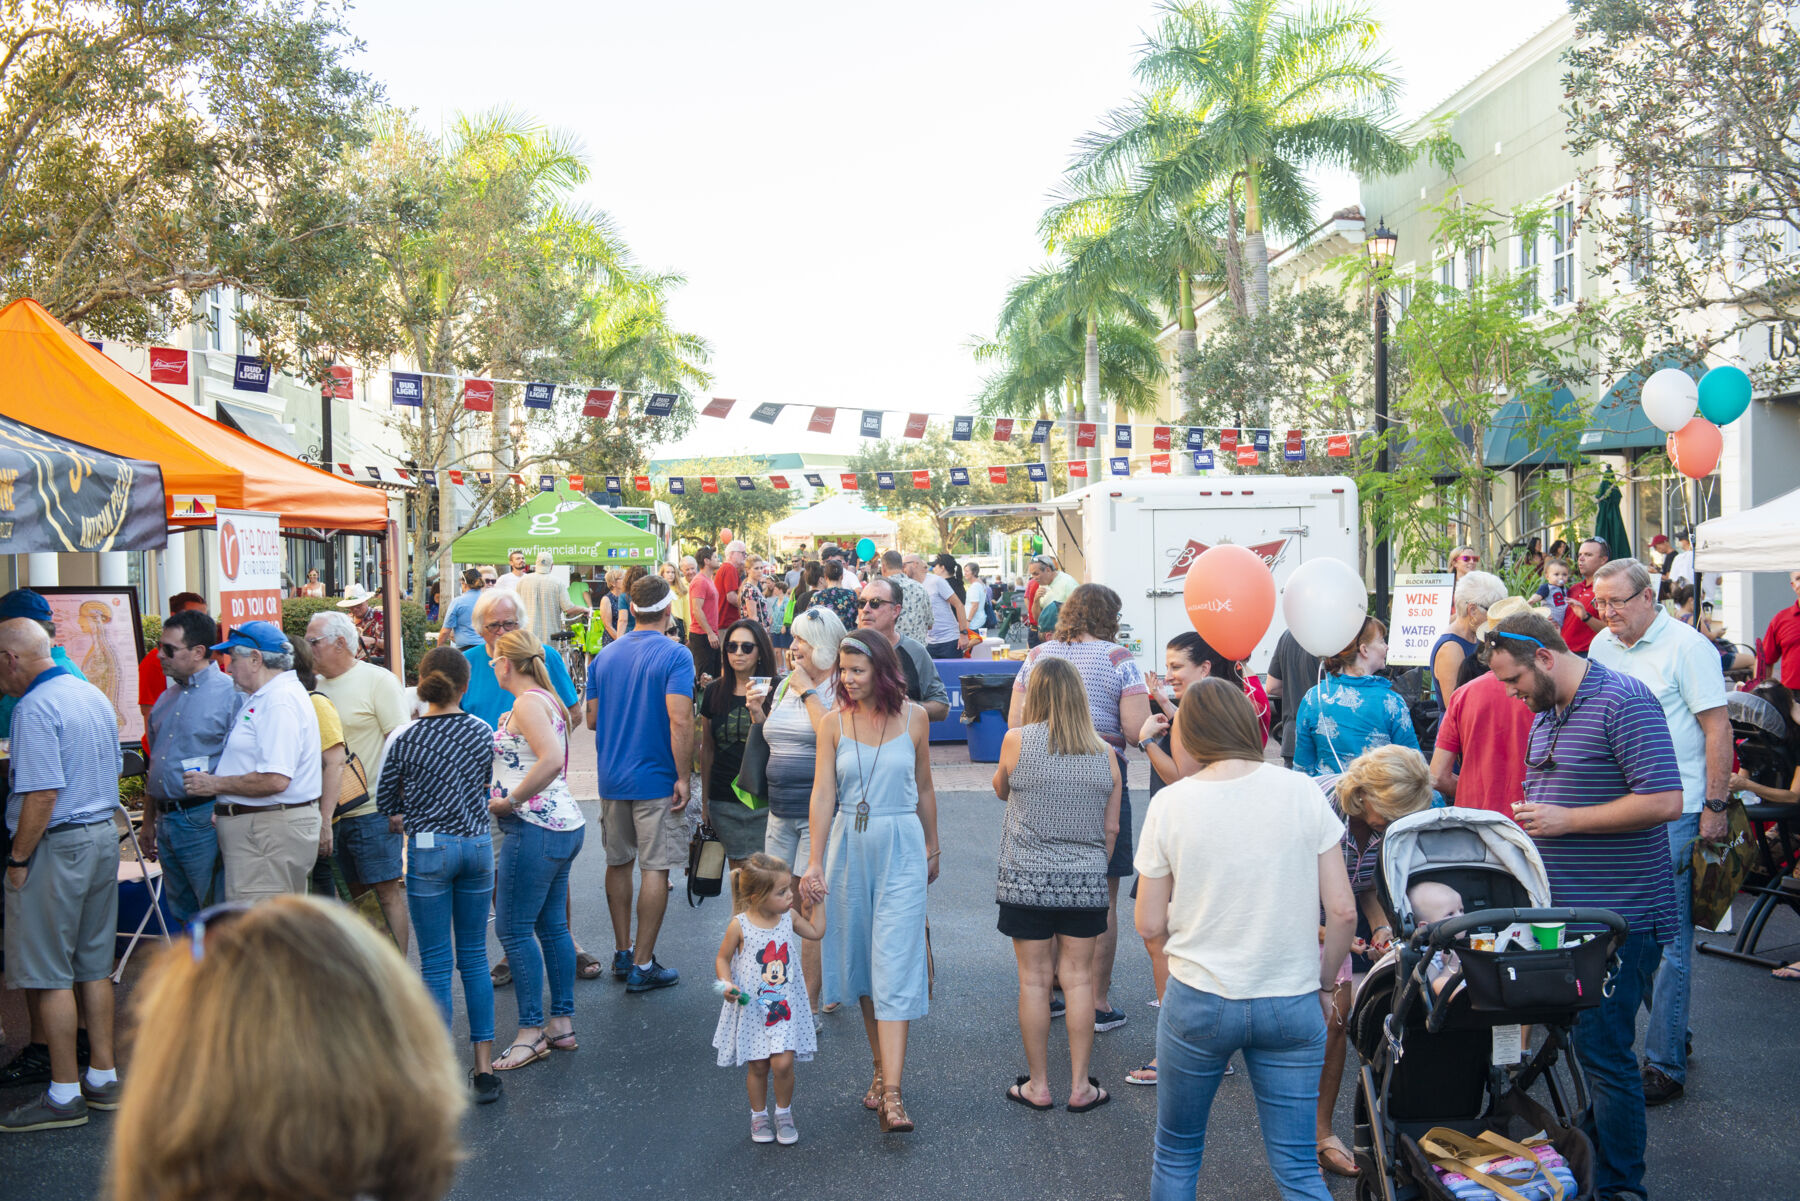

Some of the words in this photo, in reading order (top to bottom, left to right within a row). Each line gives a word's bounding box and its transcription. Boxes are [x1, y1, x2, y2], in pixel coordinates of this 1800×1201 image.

[243, 365, 262, 374] BUD
[239, 371, 264, 381] LIGHT
[399, 381, 415, 389] BUD
[532, 385, 548, 393] BUD
[396, 387, 418, 396] LIGHT
[529, 390, 550, 399] LIGHT
[864, 422, 879, 430] LIGHT
[1405, 593, 1439, 605] WINE
[231, 598, 245, 618] DO
[247, 597, 264, 616] YOU
[266, 596, 278, 614] OR
[1407, 608, 1433, 617] $5.00
[1401, 625, 1436, 636] WATER
[1404, 638, 1429, 648] $1.00
